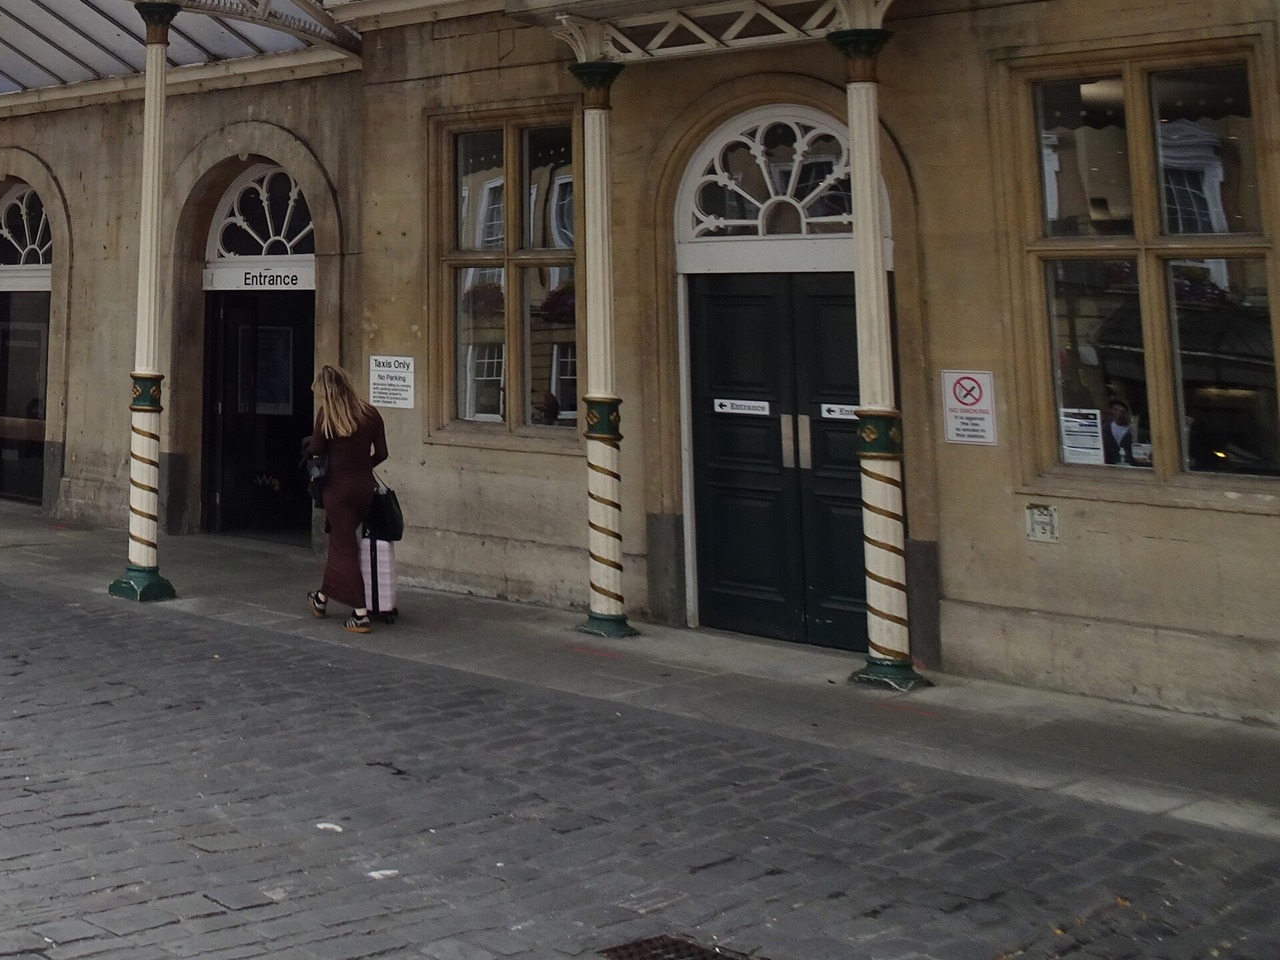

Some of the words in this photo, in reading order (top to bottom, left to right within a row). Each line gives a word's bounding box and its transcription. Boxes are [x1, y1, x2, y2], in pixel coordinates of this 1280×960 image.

[244, 272, 298, 285] Entrance
[374, 359, 392, 369] Taxis
[394, 359, 410, 370] Only
[730, 402, 767, 412] Entrance
